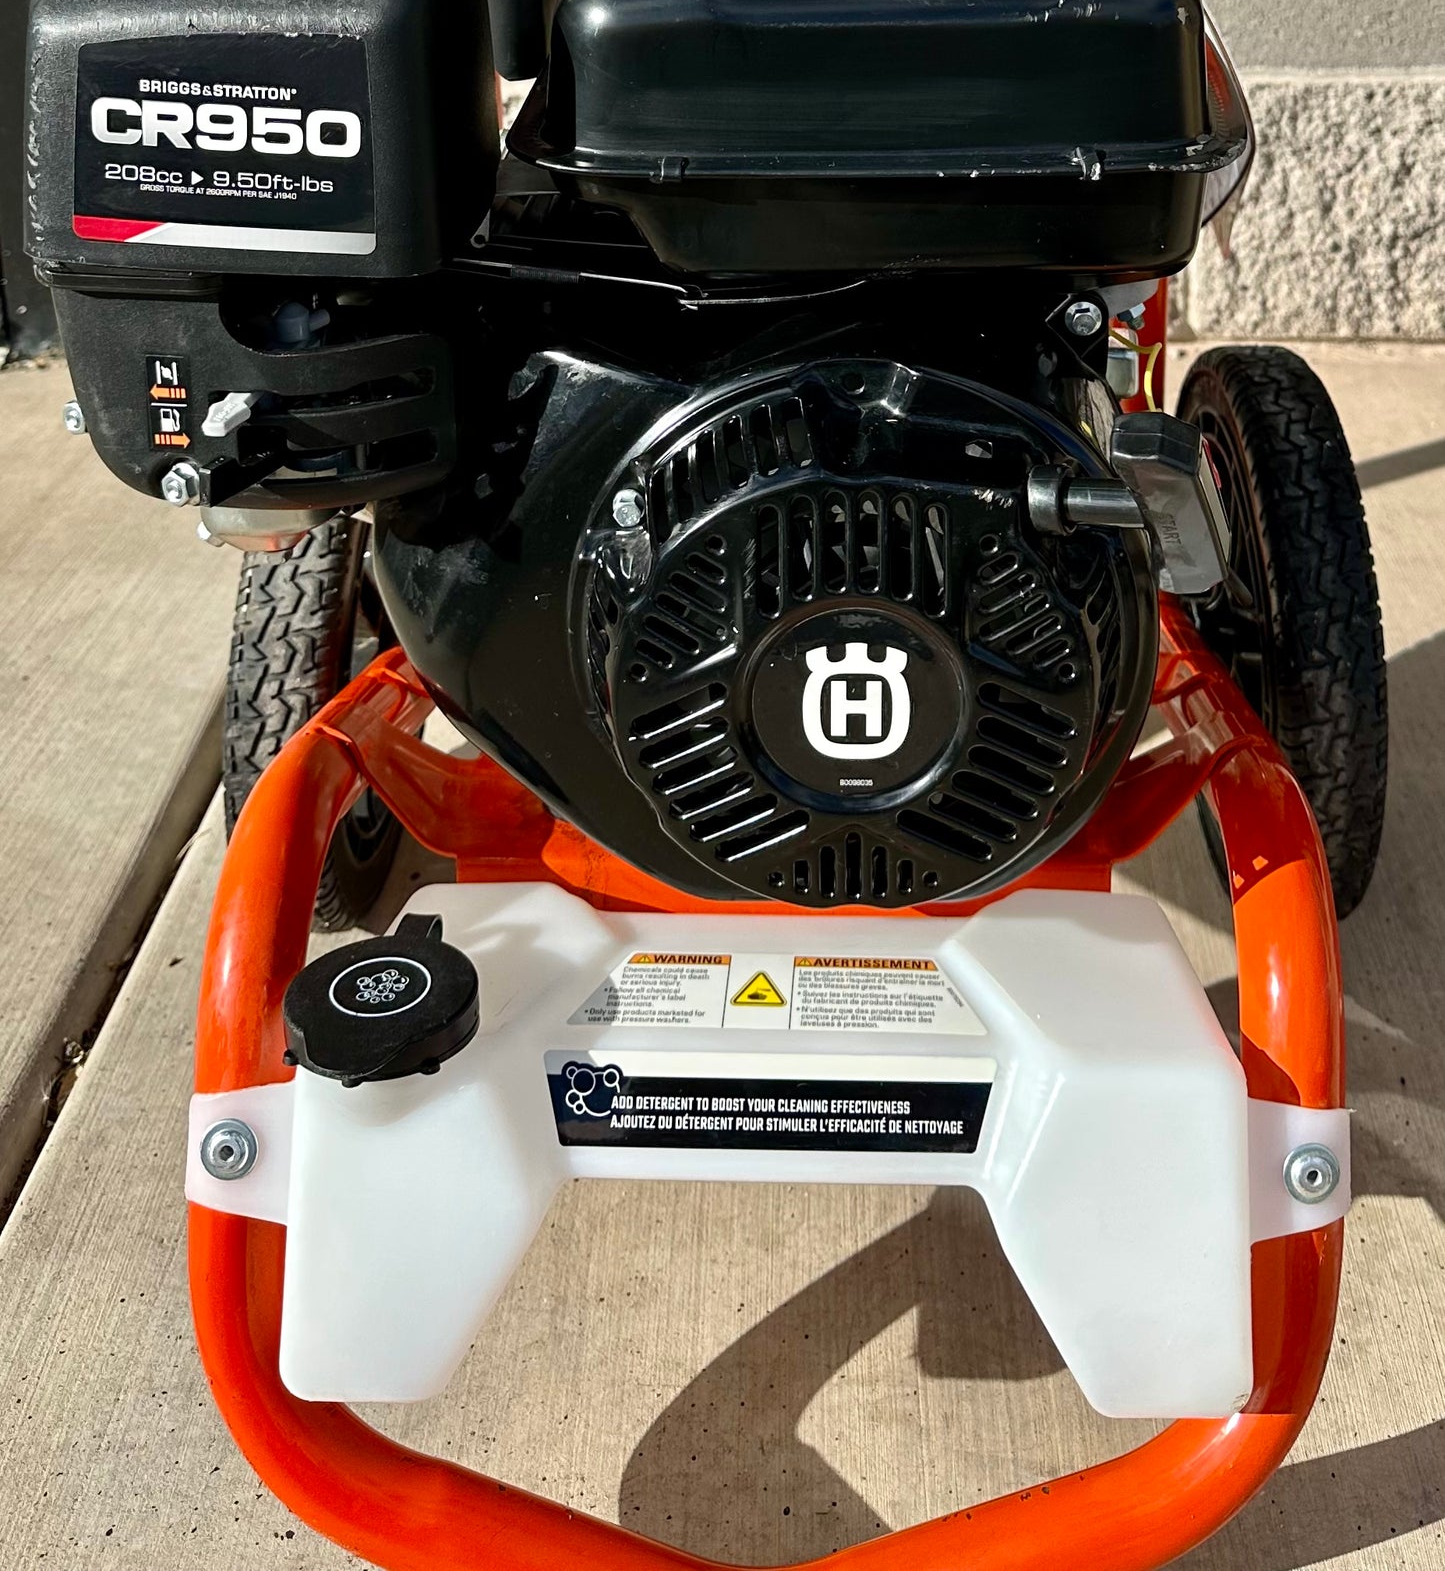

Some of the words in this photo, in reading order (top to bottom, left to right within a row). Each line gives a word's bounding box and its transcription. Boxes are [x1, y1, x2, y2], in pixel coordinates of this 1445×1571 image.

[91, 97, 362, 158] CR950
[104, 163, 183, 184] 208cc
[213, 171, 334, 193] 9.50ft-lbs
[140, 183, 164, 192] GROSS
[166, 185, 194, 194] TORQUE
[195, 187, 204, 195] AT
[243, 190, 257, 198] PER
[259, 191, 272, 199] SAE
[274, 192, 297, 200] J1940
[653, 954, 723, 965] WARNING
[813, 958, 930, 970] AVERTISSEMENT
[645, 973, 678, 981] resulting
[845, 971, 882, 979] chimiques
[842, 991, 888, 999] instructions
[590, 1008, 606, 1016] Only
[611, 1095, 634, 1109] ADD
[636, 1096, 694, 1111] DETERGENT
[696, 1097, 709, 1111] TO
[711, 1097, 745, 1112] BOOST
[747, 1098, 775, 1112] YOUR
[777, 1099, 828, 1113] CLEANING
[830, 1099, 911, 1114] EFFECTIVENESS
[610, 1114, 656, 1129] AJOUTEZ
[658, 1115, 672, 1129] DU
[675, 1113, 734, 1131] DÉTERGENT
[735, 1117, 764, 1131] POUR
[766, 1117, 817, 1132] STIMULER
[819, 1116, 886, 1133] L'EFFICACITÉ
[889, 1119, 902, 1134] DE
[904, 1120, 964, 1135] NETTOYAGE
